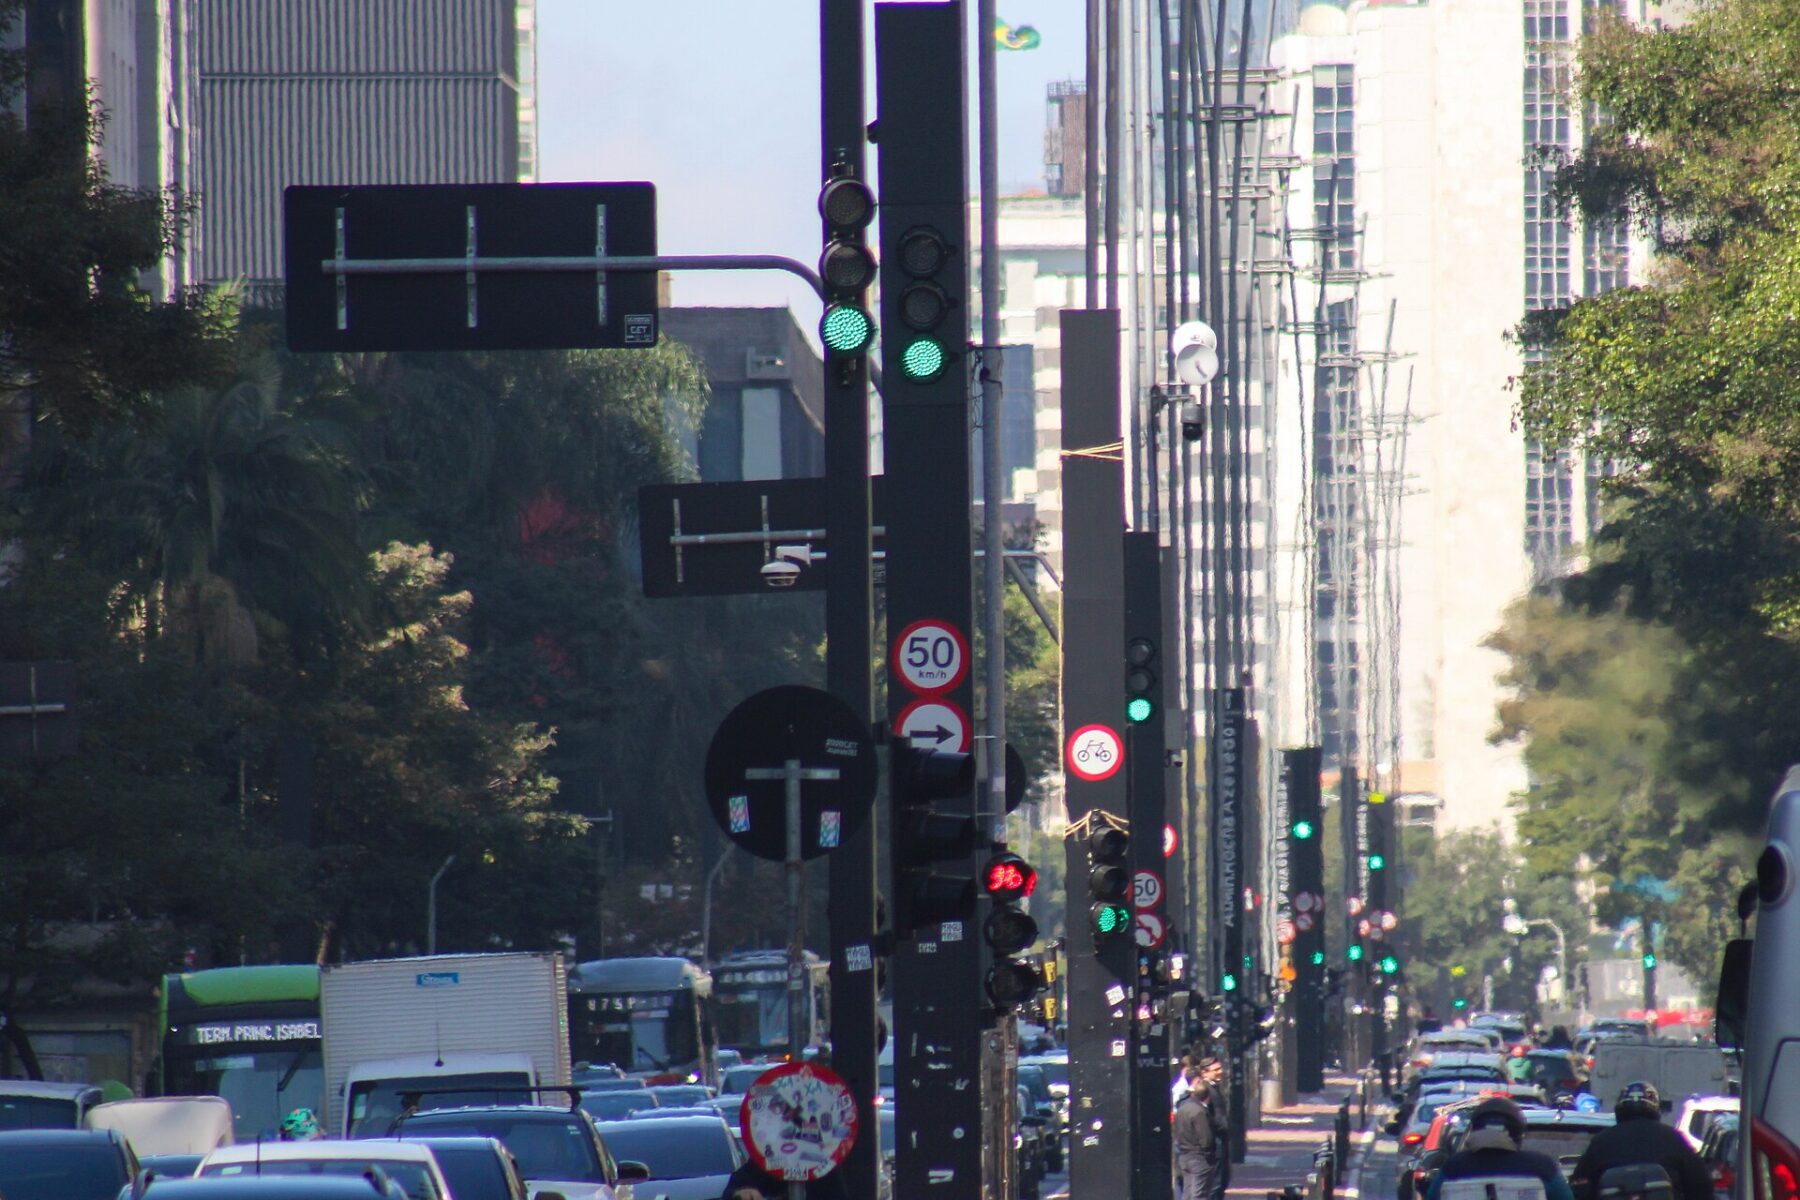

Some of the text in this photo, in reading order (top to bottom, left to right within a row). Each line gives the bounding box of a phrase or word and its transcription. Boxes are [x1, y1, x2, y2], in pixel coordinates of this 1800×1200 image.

[907, 636, 955, 668] 50
[917, 670, 947, 679] km/h
[1134, 878, 1157, 896] 50
[196, 1023, 322, 1044] TERM. PRINC. ISABEL
